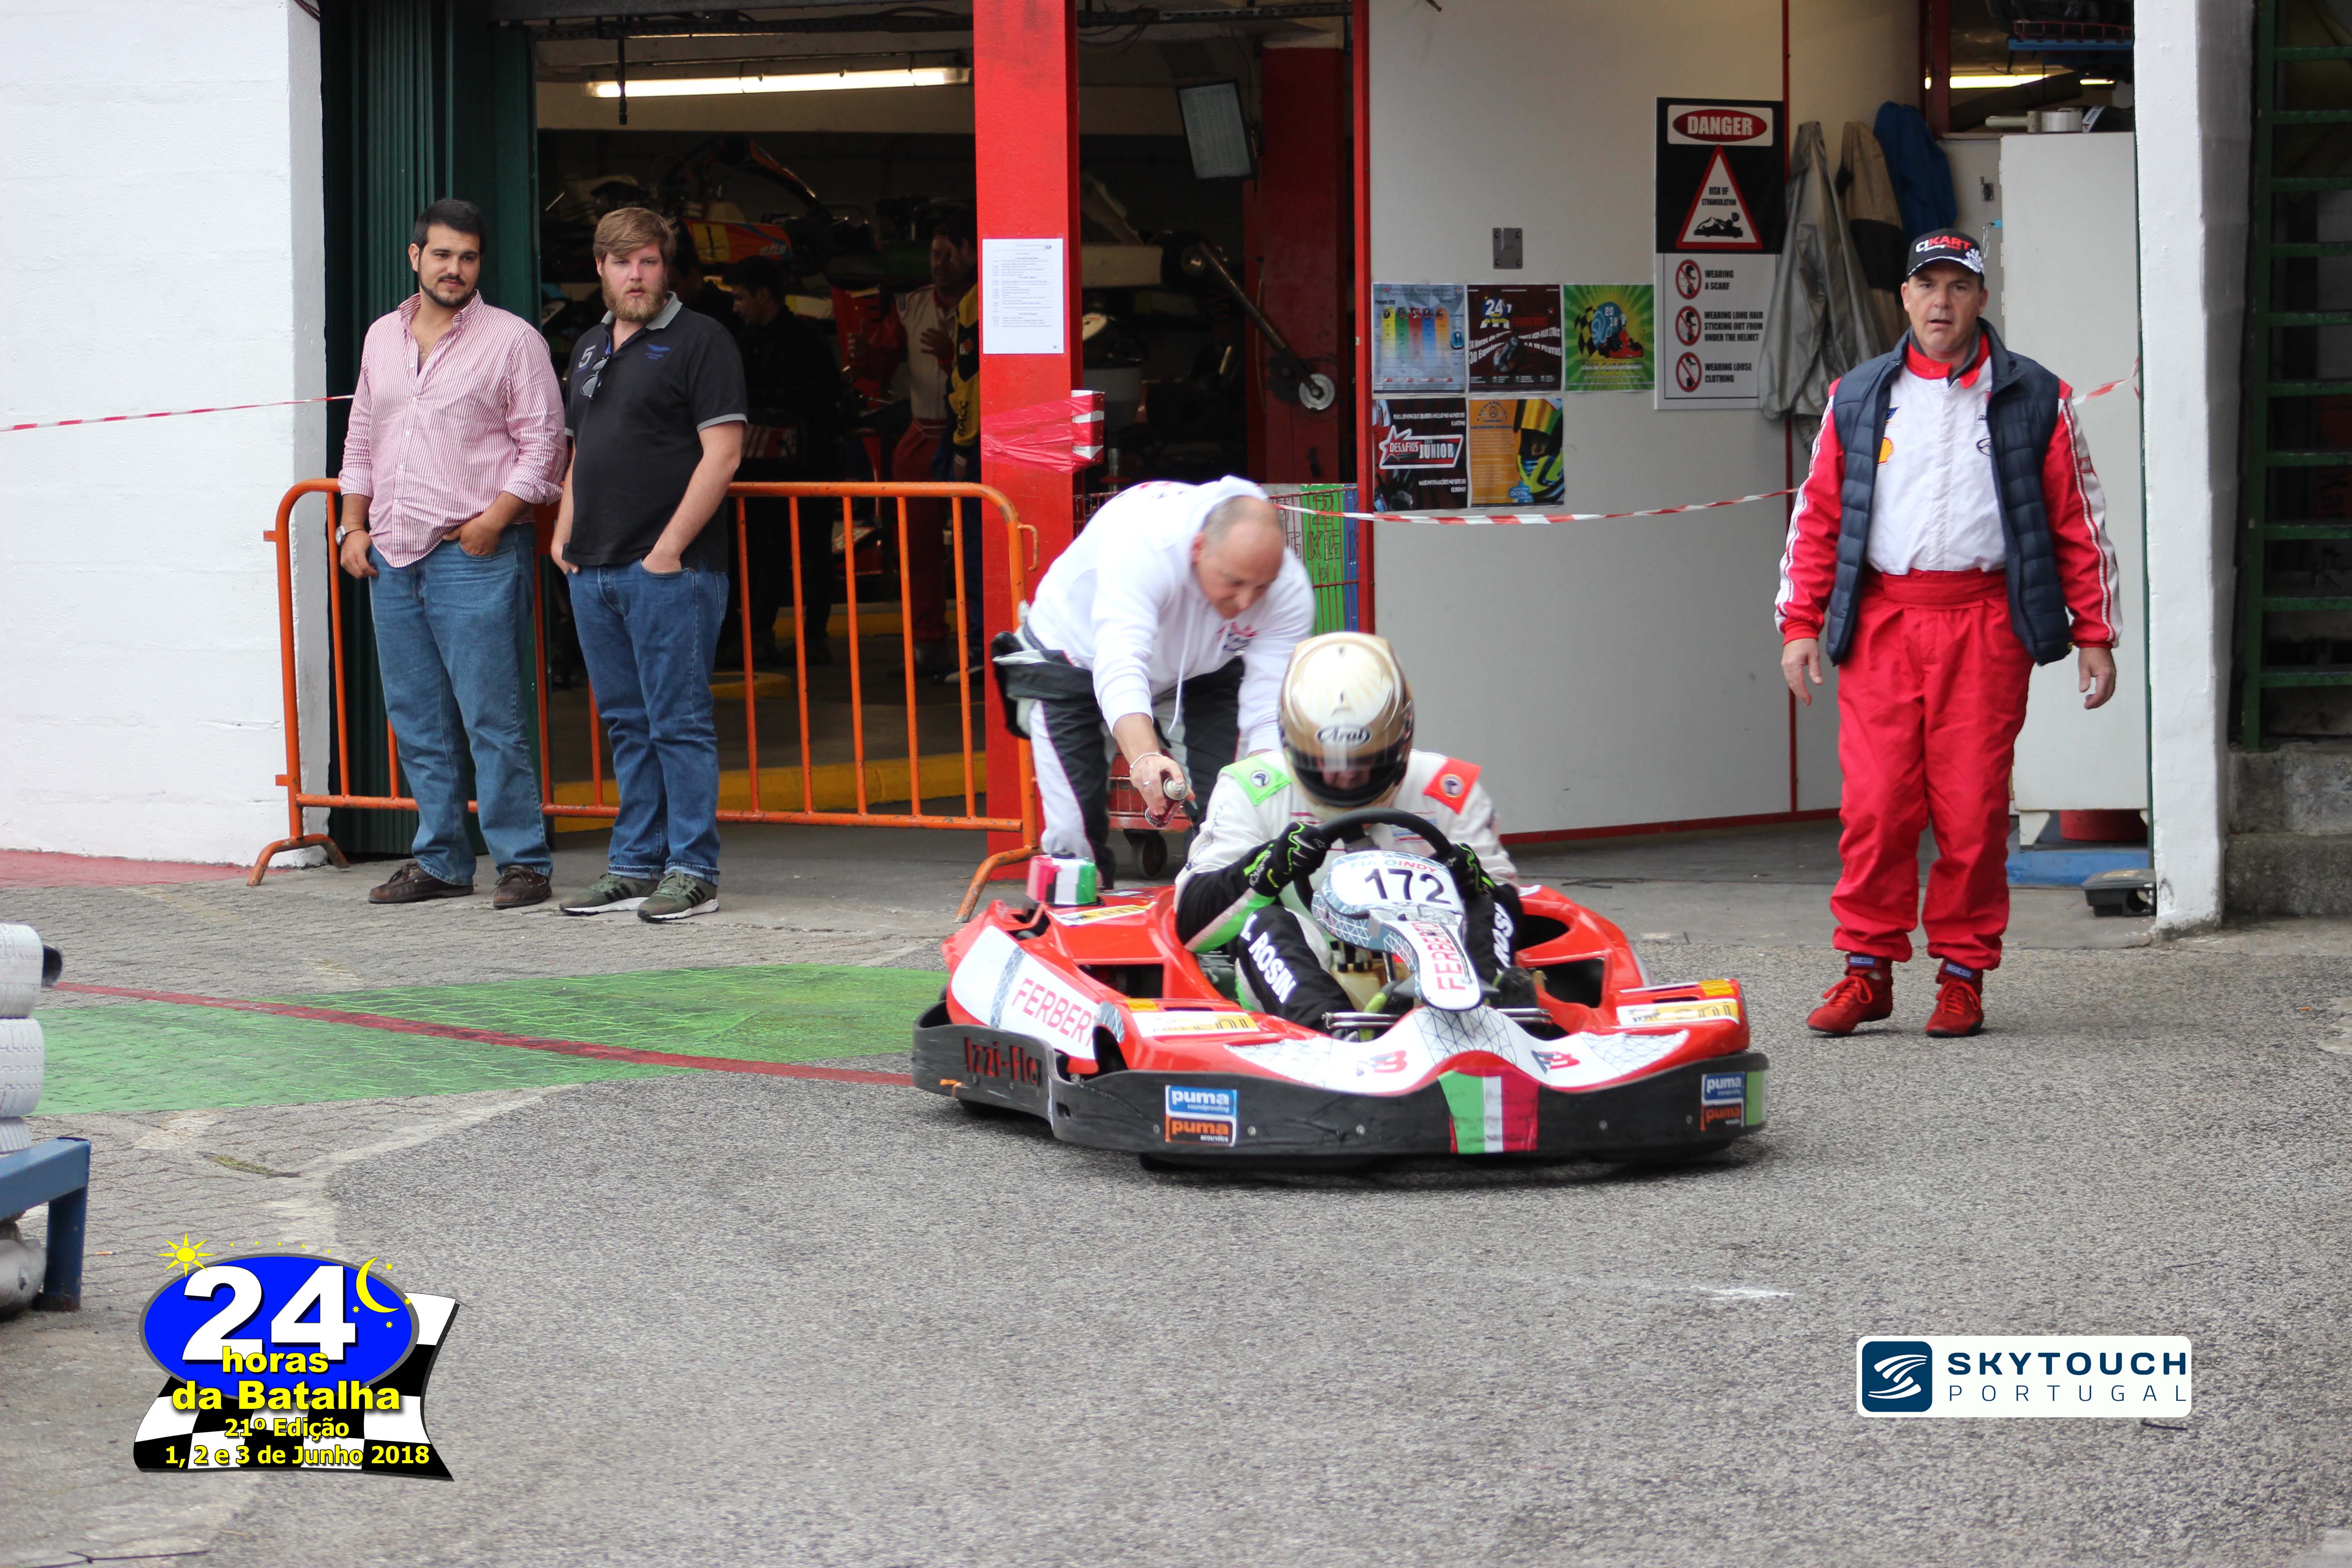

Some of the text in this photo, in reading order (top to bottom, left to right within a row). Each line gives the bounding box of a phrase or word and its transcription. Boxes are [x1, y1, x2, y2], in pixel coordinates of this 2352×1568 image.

[1687, 116, 1752, 136] DANGER
[1709, 186, 1729, 196] RISK OF
[1916, 235, 1971, 252] CIKART
[1705, 270, 1734, 279] WEARING
[1710, 282, 1730, 290] SCARF
[1485, 299, 1503, 316] 24
[1605, 306, 1613, 316] 20
[1609, 317, 1617, 327] 18
[1704, 311, 1763, 319] WEARING LONG HAIR
[1737, 333, 1759, 342] HELMET
[578, 344, 597, 368] 5
[1541, 344, 1561, 356] PILOTOS
[1469, 351, 1478, 364] 30
[1734, 363, 1752, 371] LOOSE
[1705, 375, 1734, 383] CLOTHING
[1390, 441, 1419, 453] DESAFIOS
[1419, 443, 1454, 459] JUNIOR
[1364, 867, 1452, 905] 172
[1248, 931, 1296, 1004] ROSIN
[1945, 963, 1972, 977] sparco
[1706, 1077, 1741, 1094] puma
[1171, 1090, 1230, 1105] puma
[1706, 1106, 1740, 1124] puma
[1171, 1120, 1229, 1136] puma
